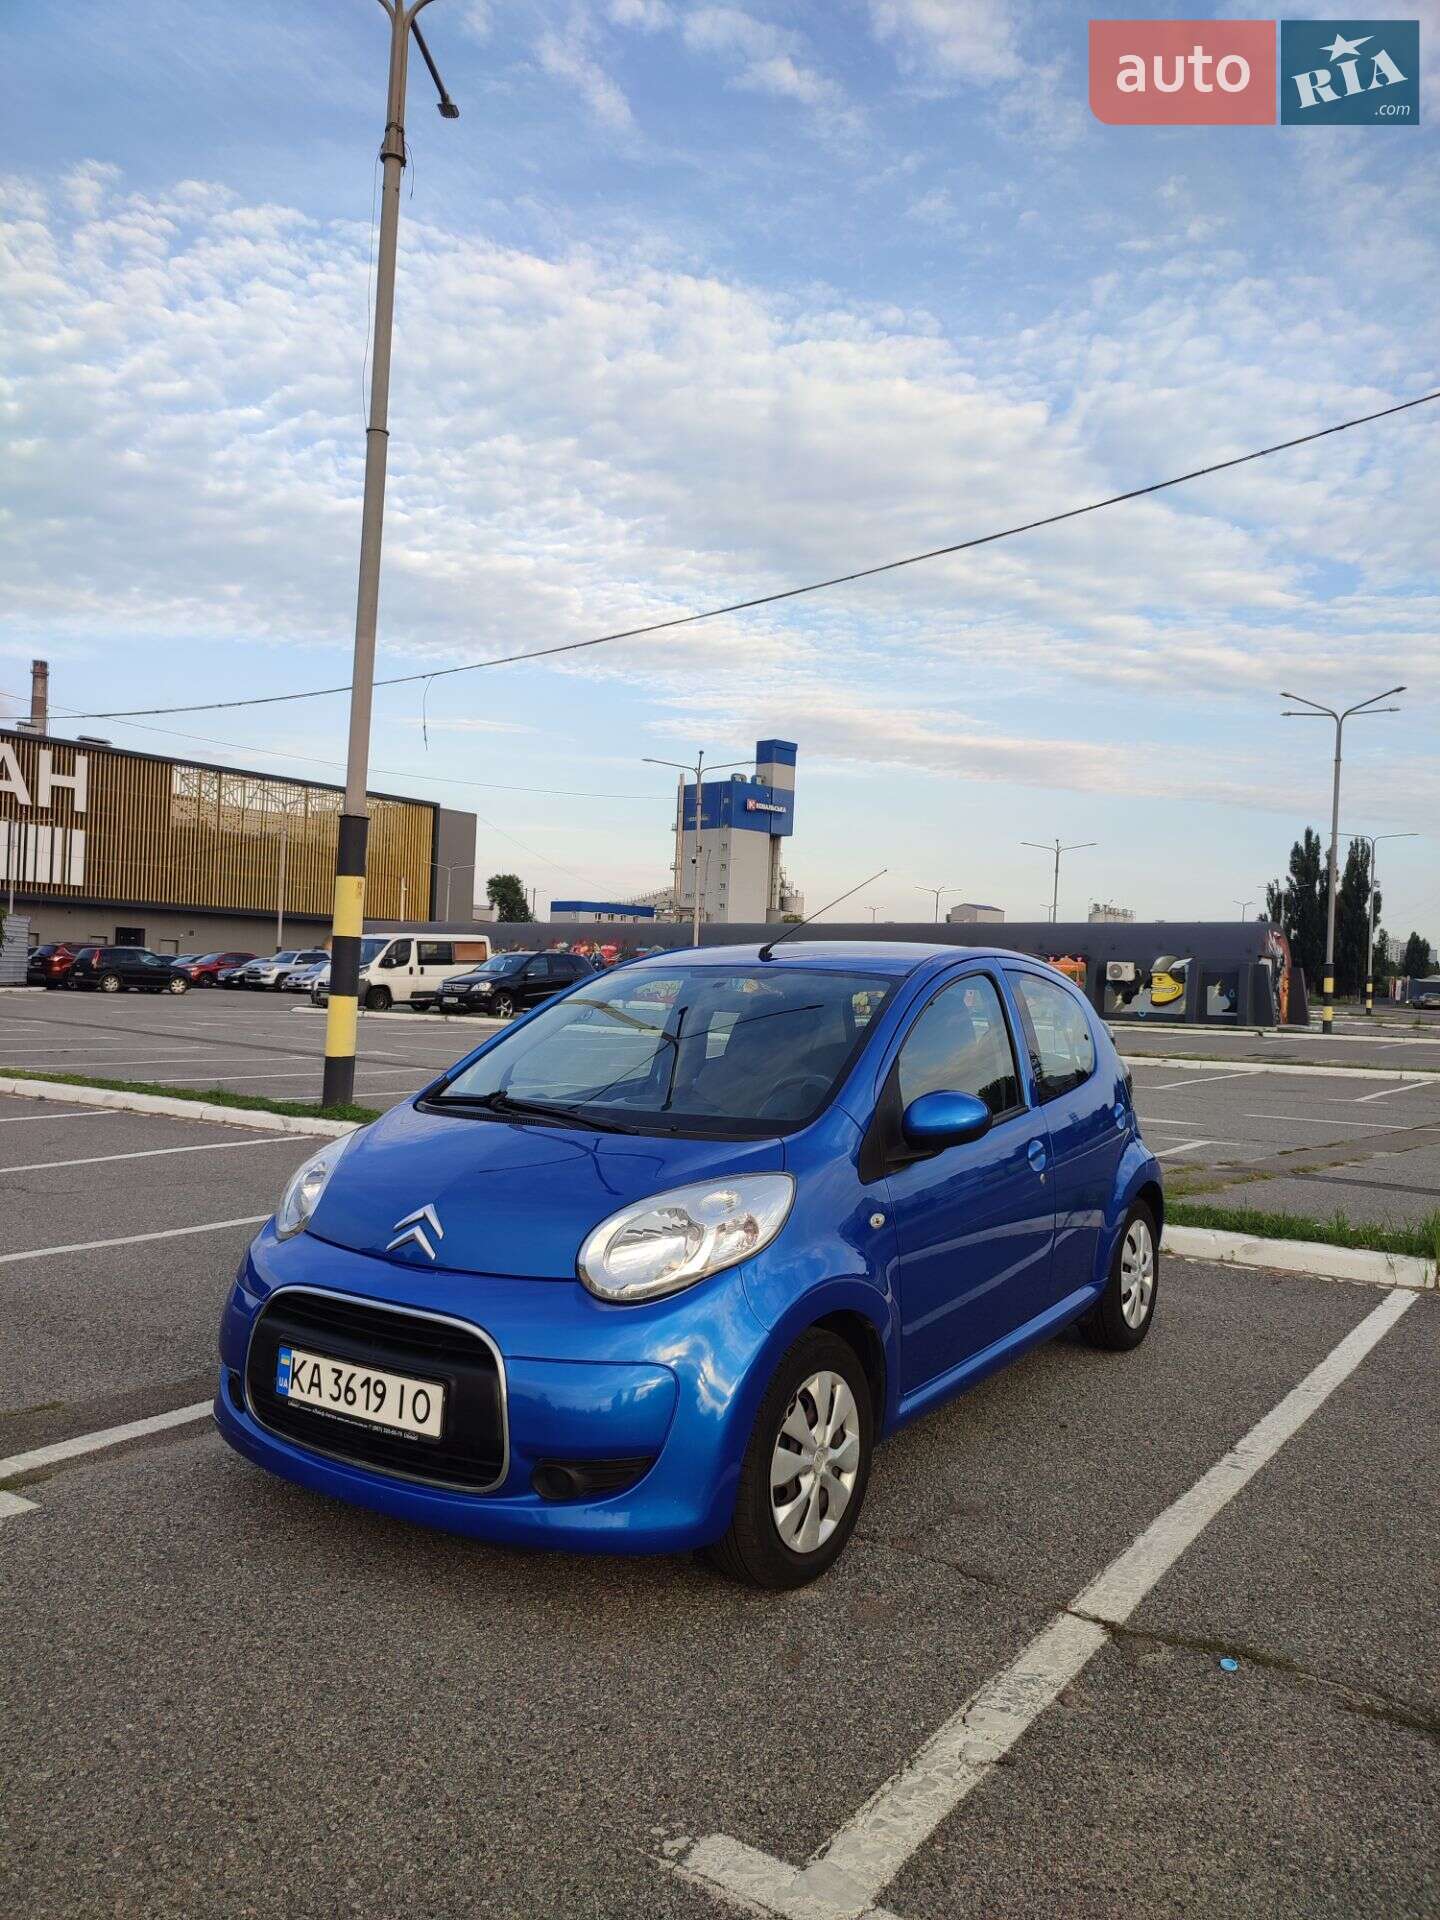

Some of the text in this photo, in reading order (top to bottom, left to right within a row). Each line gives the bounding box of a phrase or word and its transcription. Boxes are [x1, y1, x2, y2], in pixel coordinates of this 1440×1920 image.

[278, 1377, 289, 1389] UA
[290, 1357, 322, 1398] KA
[329, 1368, 387, 1413] 3619
[398, 1384, 431, 1424] IO
